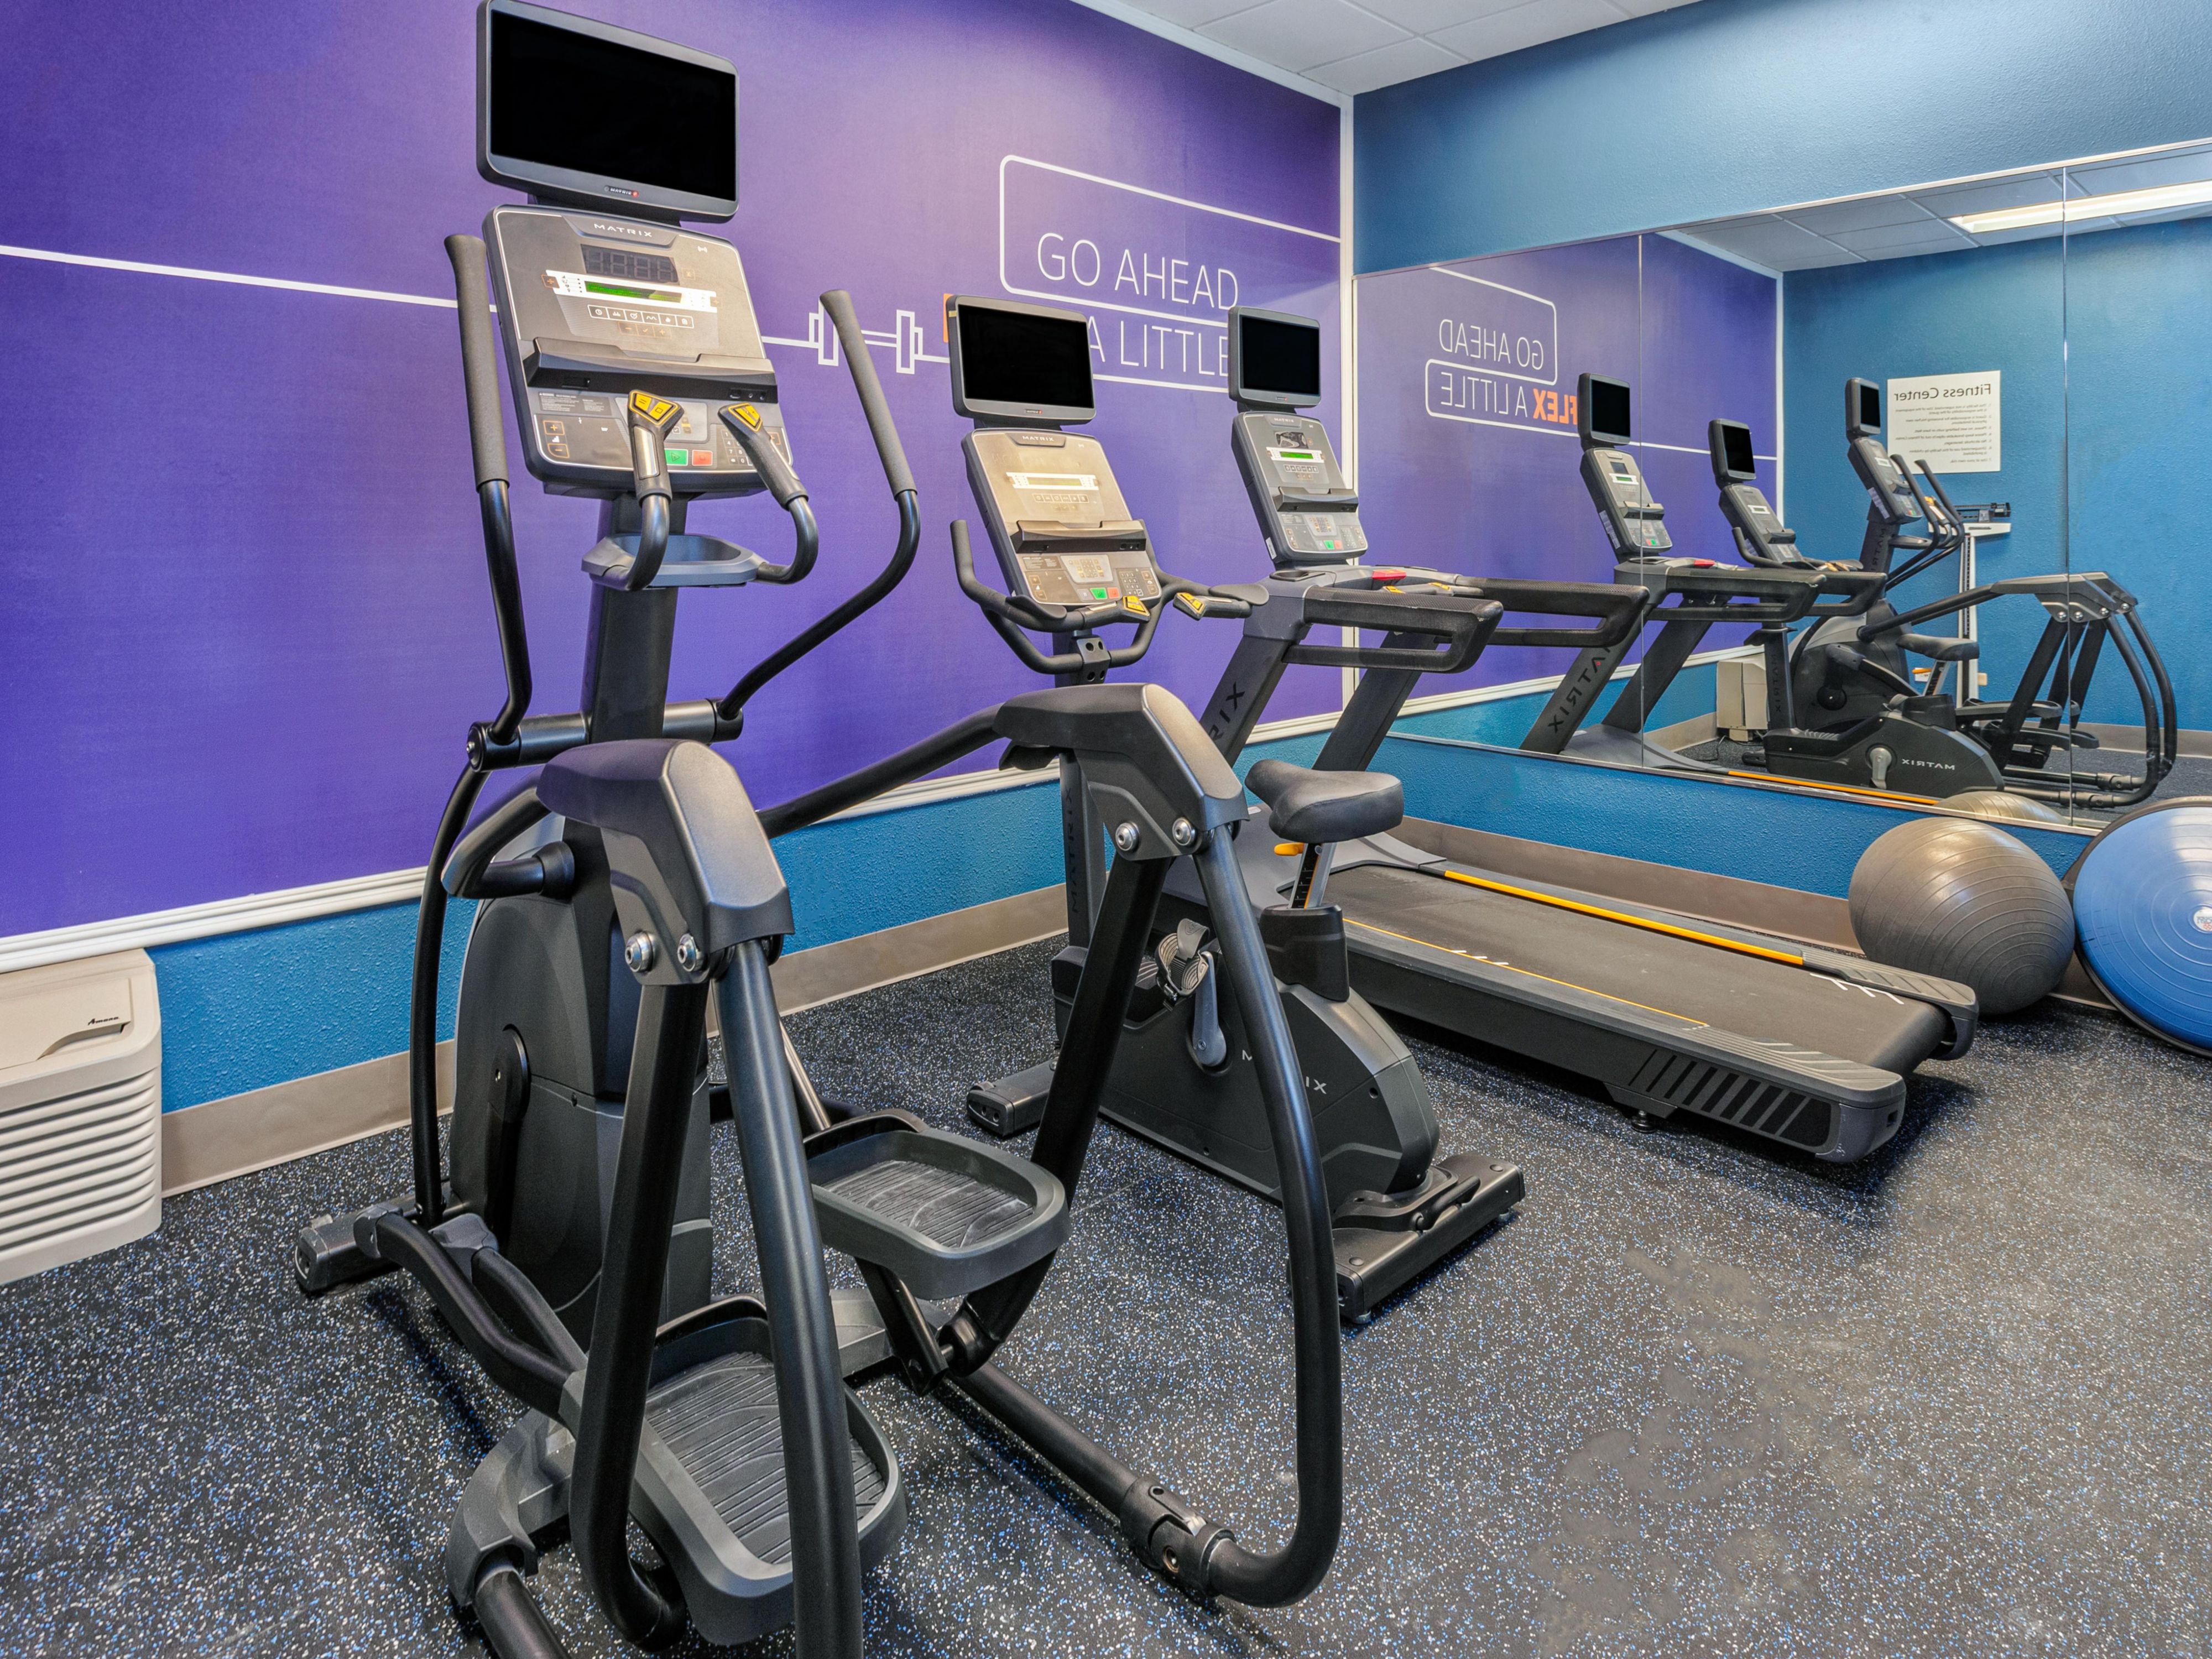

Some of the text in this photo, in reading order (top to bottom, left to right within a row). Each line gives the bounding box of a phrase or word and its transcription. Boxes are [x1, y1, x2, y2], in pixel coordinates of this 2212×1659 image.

[594, 223, 652, 237] MATRIX
[1037, 233, 1239, 310] GO AHEAD
[1120, 320, 1228, 377] LITTLE
[1208, 681, 1245, 740] RIX
[88, 1016, 119, 1025] Amana
[1242, 1050, 1327, 1094] MIX
